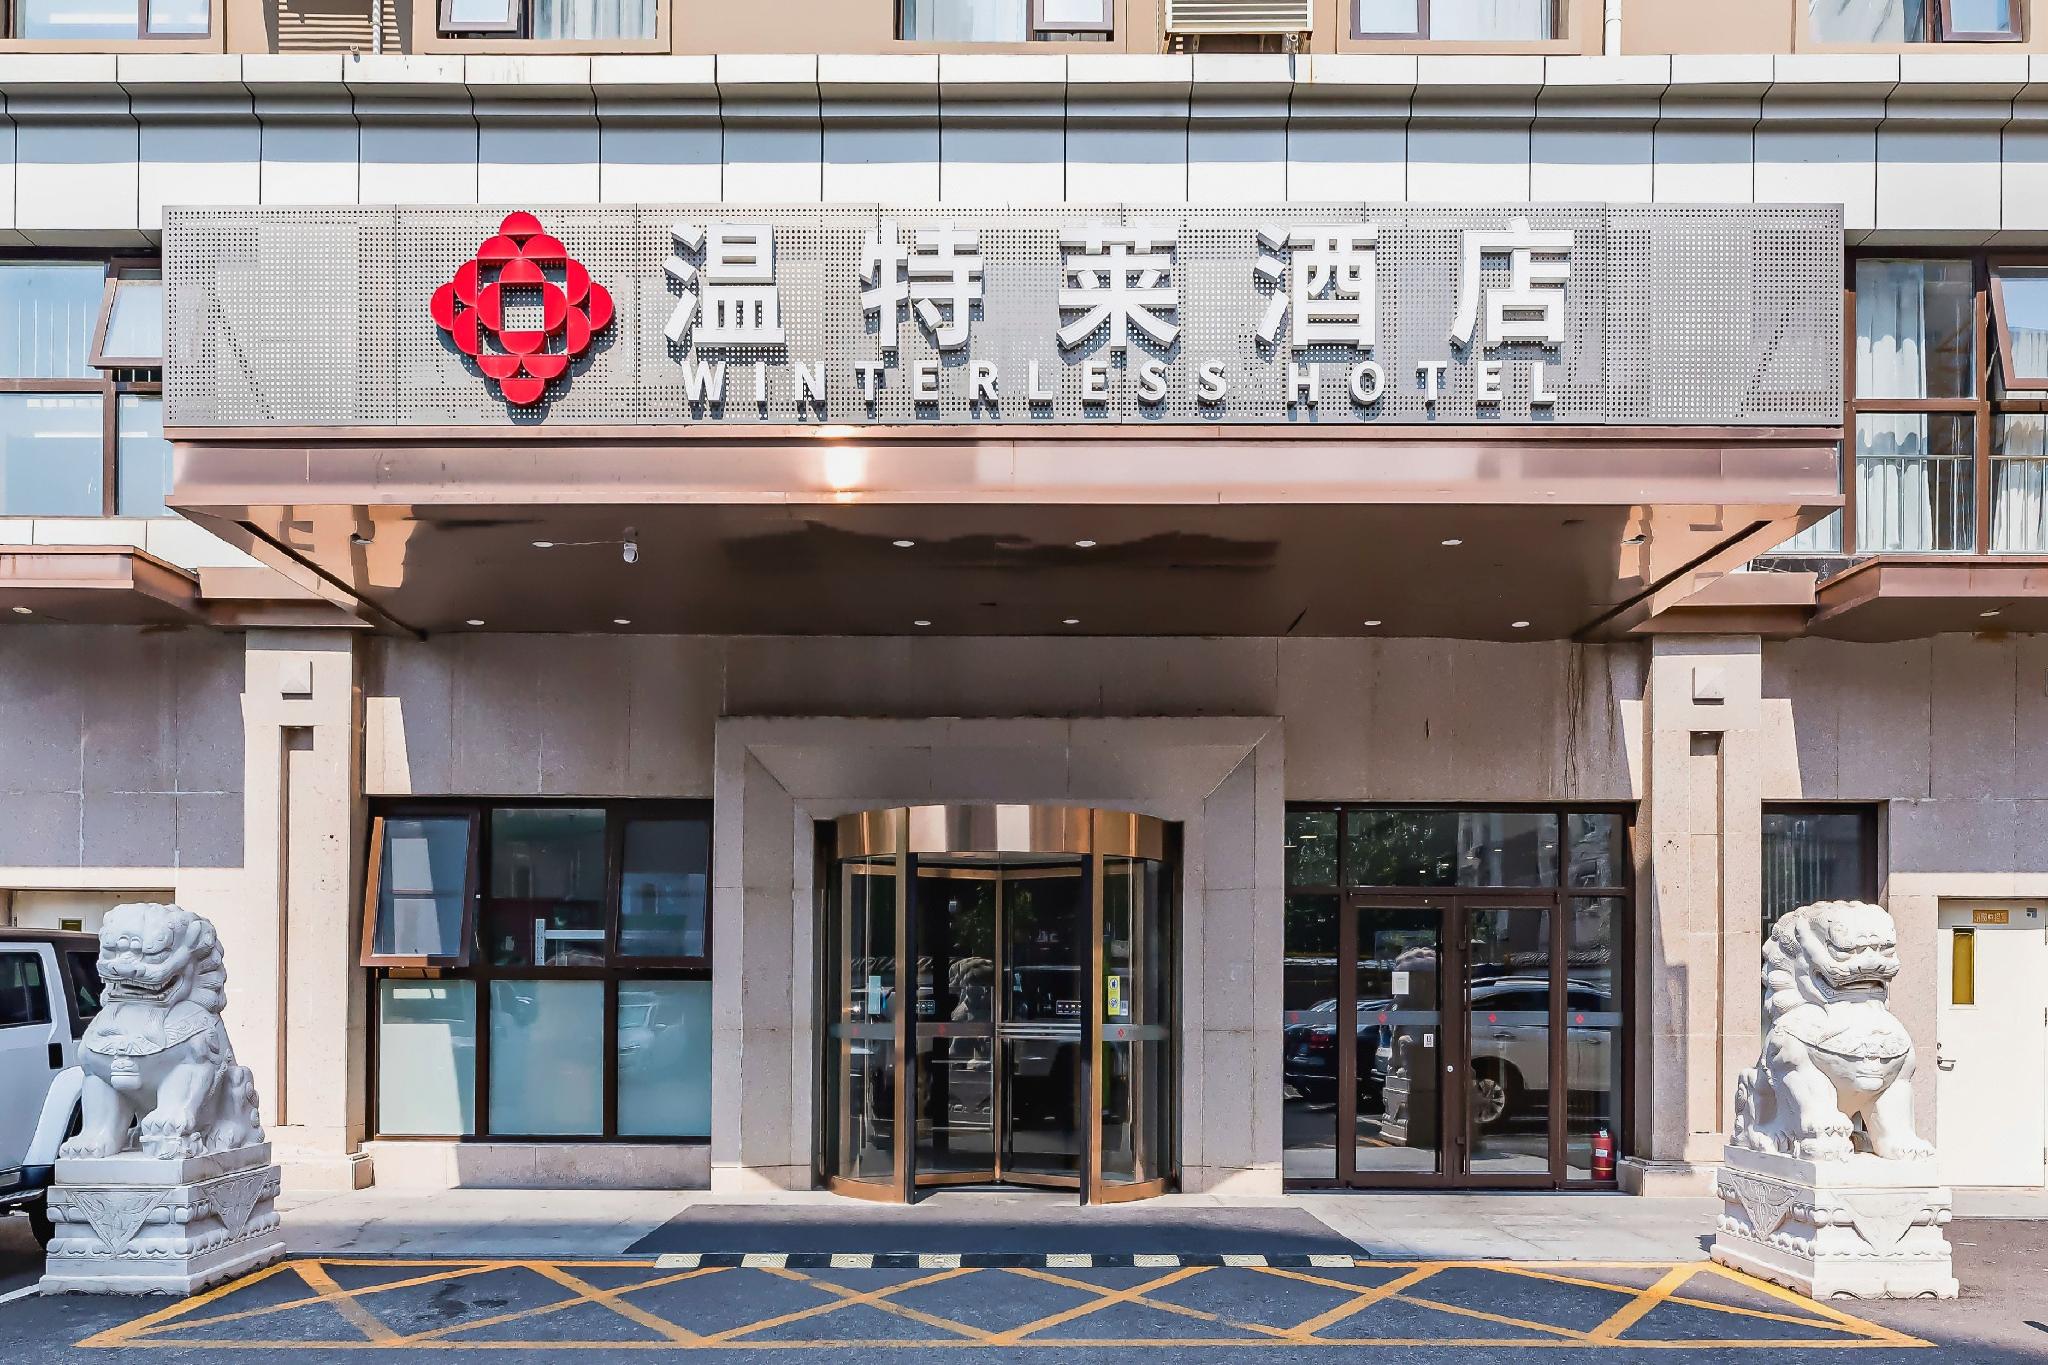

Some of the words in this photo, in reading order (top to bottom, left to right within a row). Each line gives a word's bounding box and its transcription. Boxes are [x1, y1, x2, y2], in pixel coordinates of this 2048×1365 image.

[663, 217, 1575, 351] 温特莱酒店
[681, 359, 1227, 402] WINTERLESS
[1288, 360, 1557, 402] HOTEL
